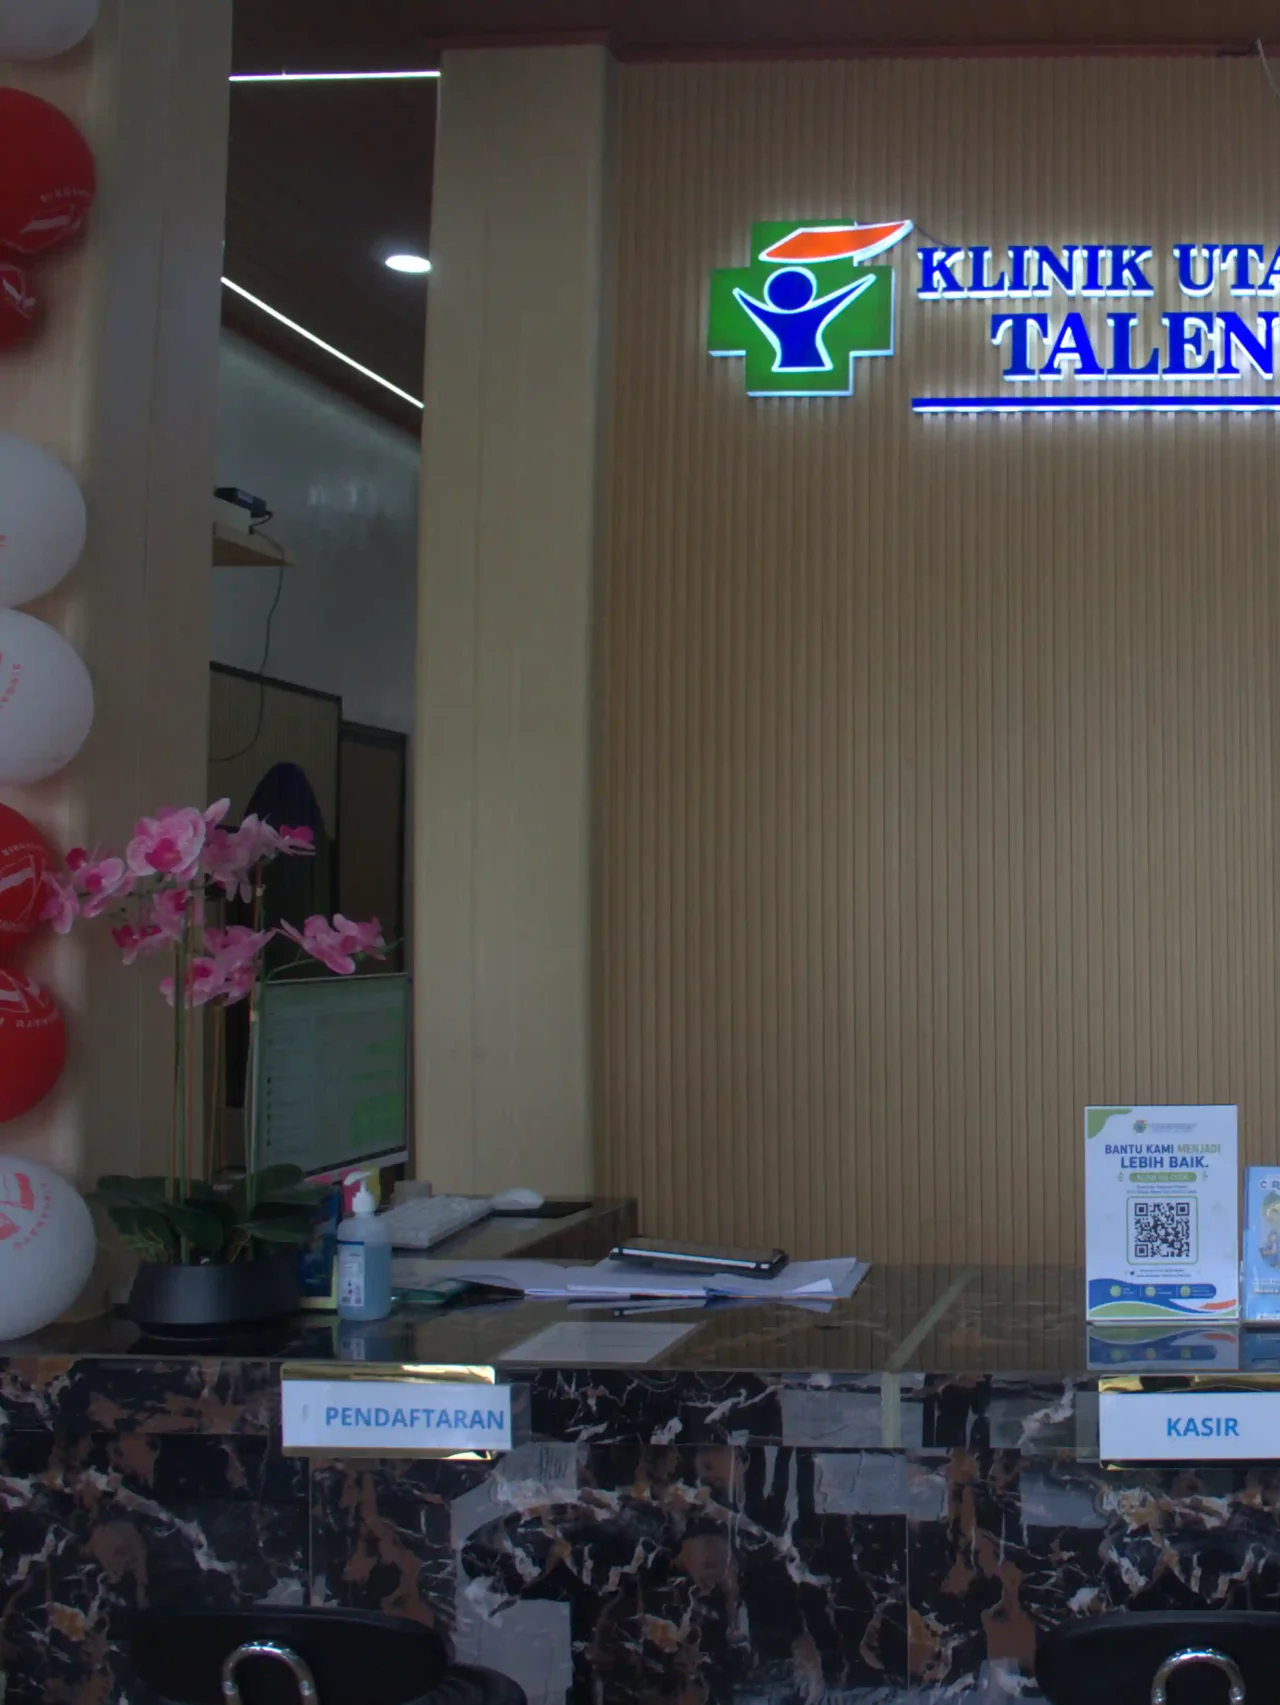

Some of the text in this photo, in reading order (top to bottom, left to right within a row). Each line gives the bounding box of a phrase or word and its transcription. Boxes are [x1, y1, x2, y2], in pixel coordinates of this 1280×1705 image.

[917, 245, 1155, 299] KLINIK
[1105, 1143, 1221, 1155] BANTU KAMI MENJADI
[1121, 1156, 1209, 1169] LEBIH BAIK.
[325, 1406, 504, 1430] PENDAFTARAN
[1167, 1417, 1239, 1437] KASIR
